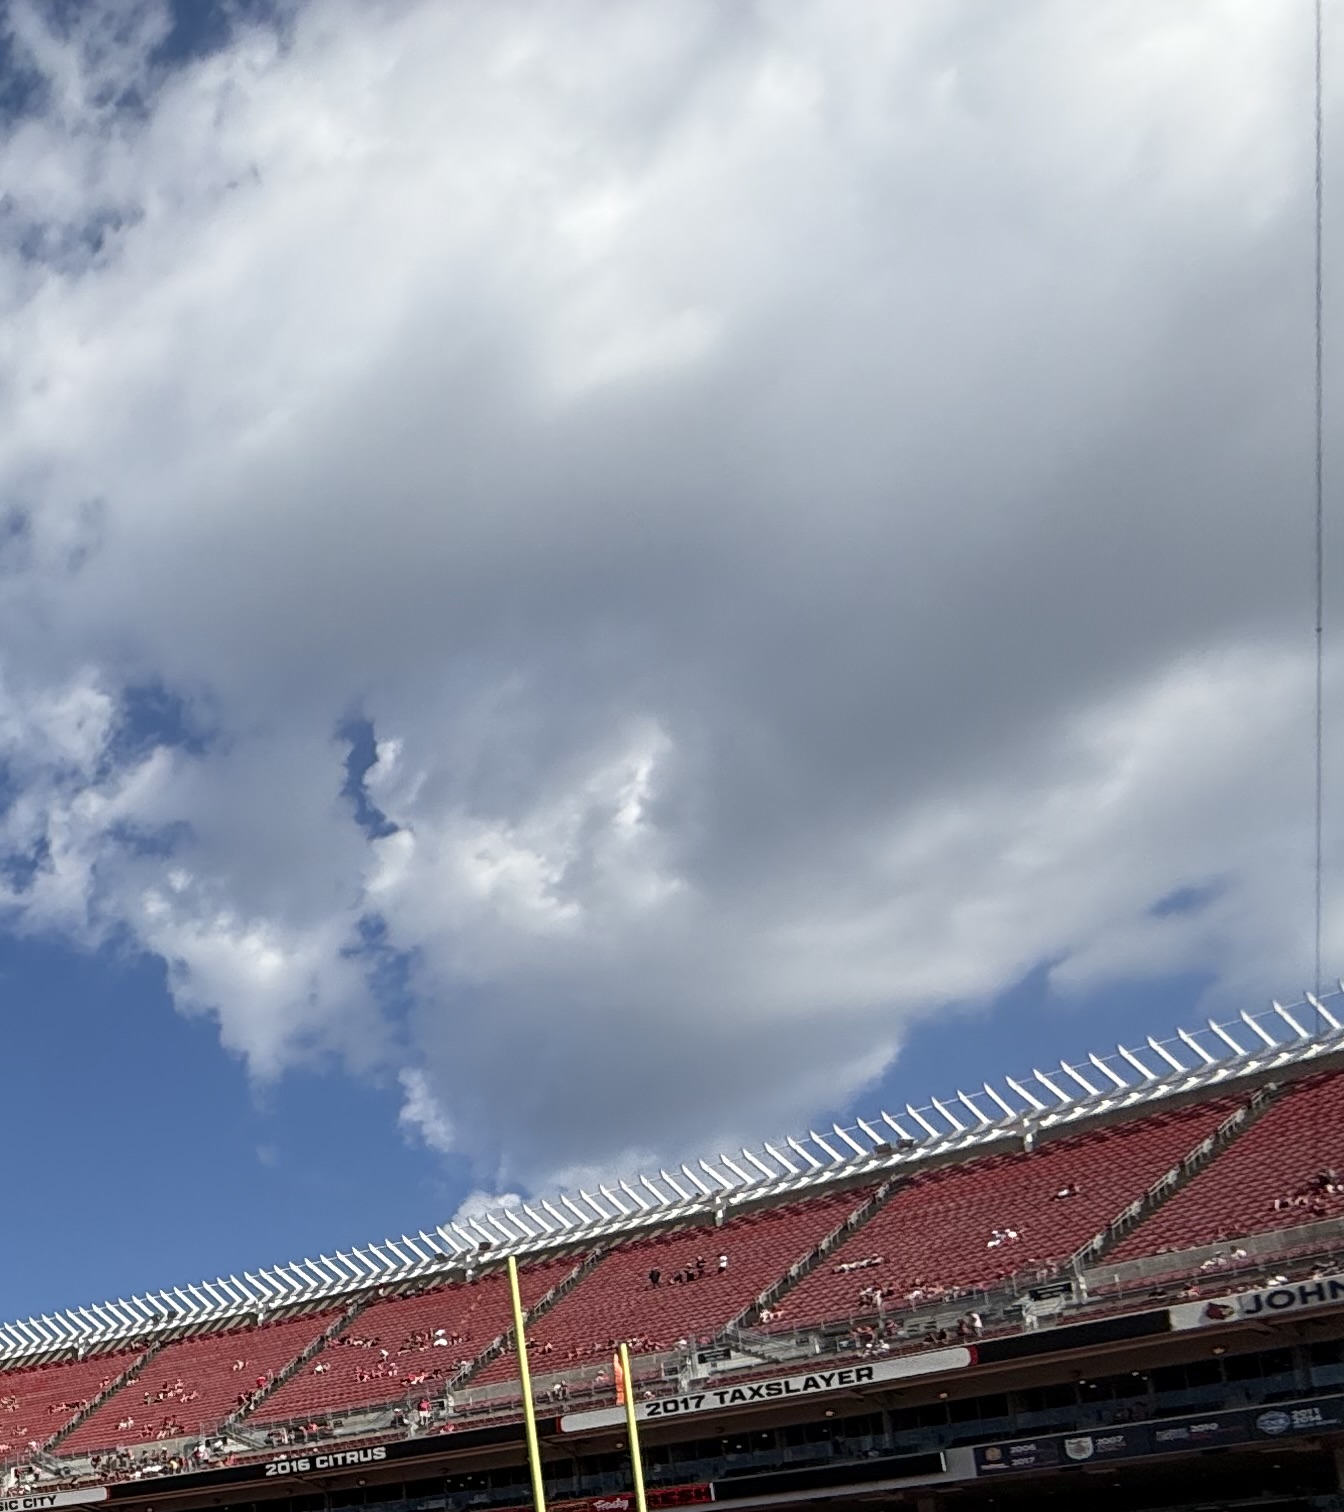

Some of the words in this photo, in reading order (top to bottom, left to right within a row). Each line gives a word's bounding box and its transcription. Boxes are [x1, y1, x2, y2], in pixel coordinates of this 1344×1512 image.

[646, 1395, 707, 1417] 2017
[713, 1366, 874, 1405] TAXSLAYER
[265, 1459, 311, 1476] 2016
[315, 1446, 387, 1469] CITRUS
[22, 1494, 58, 1510] CITY
